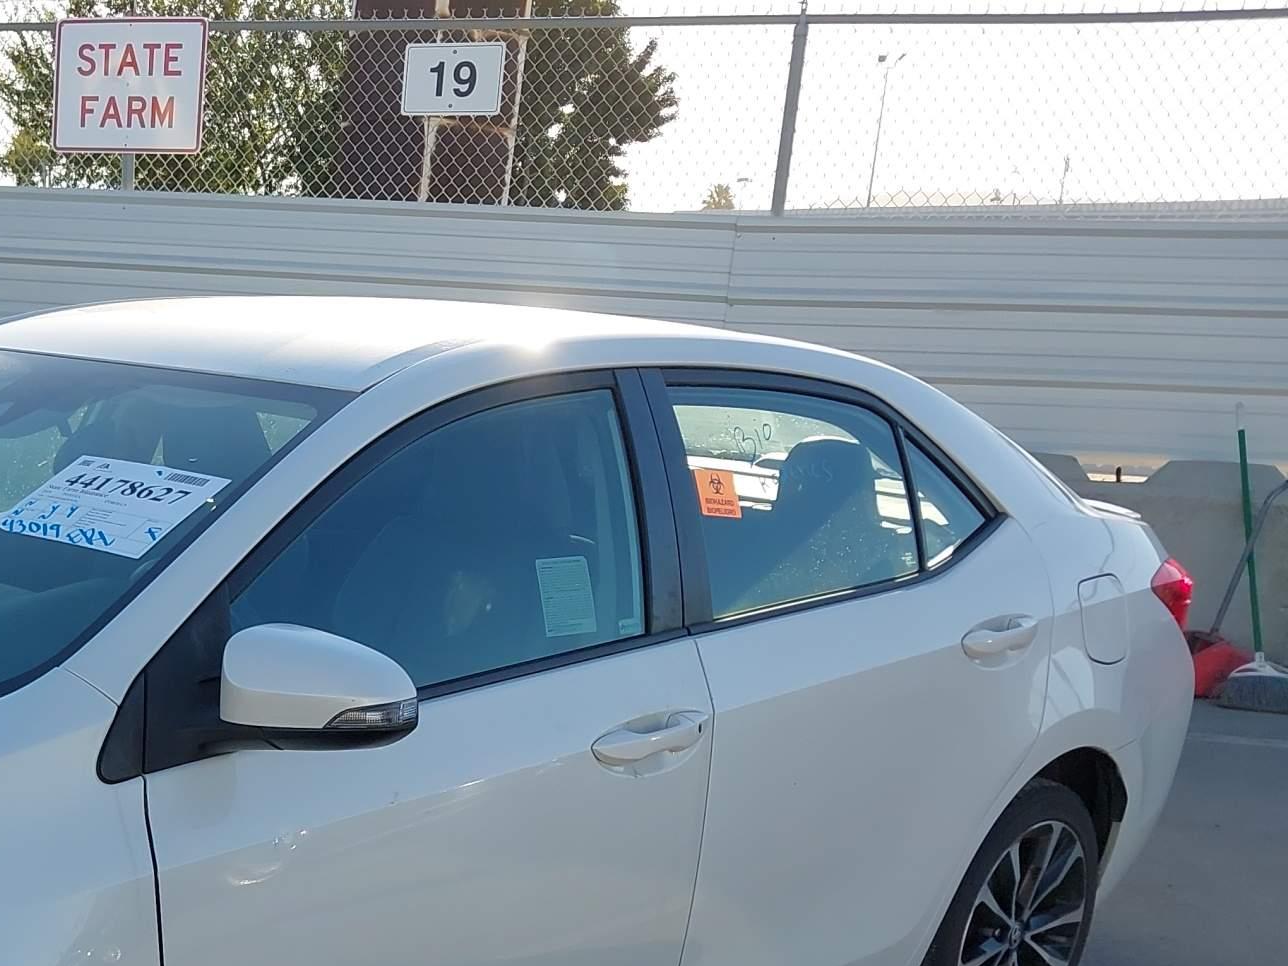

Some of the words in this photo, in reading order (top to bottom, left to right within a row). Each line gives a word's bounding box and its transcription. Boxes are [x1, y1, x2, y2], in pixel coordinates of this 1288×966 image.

[77, 43, 183, 77] STATE
[429, 60, 477, 98] 19
[80, 95, 175, 129] FARM
[65, 472, 192, 505] 44178627
